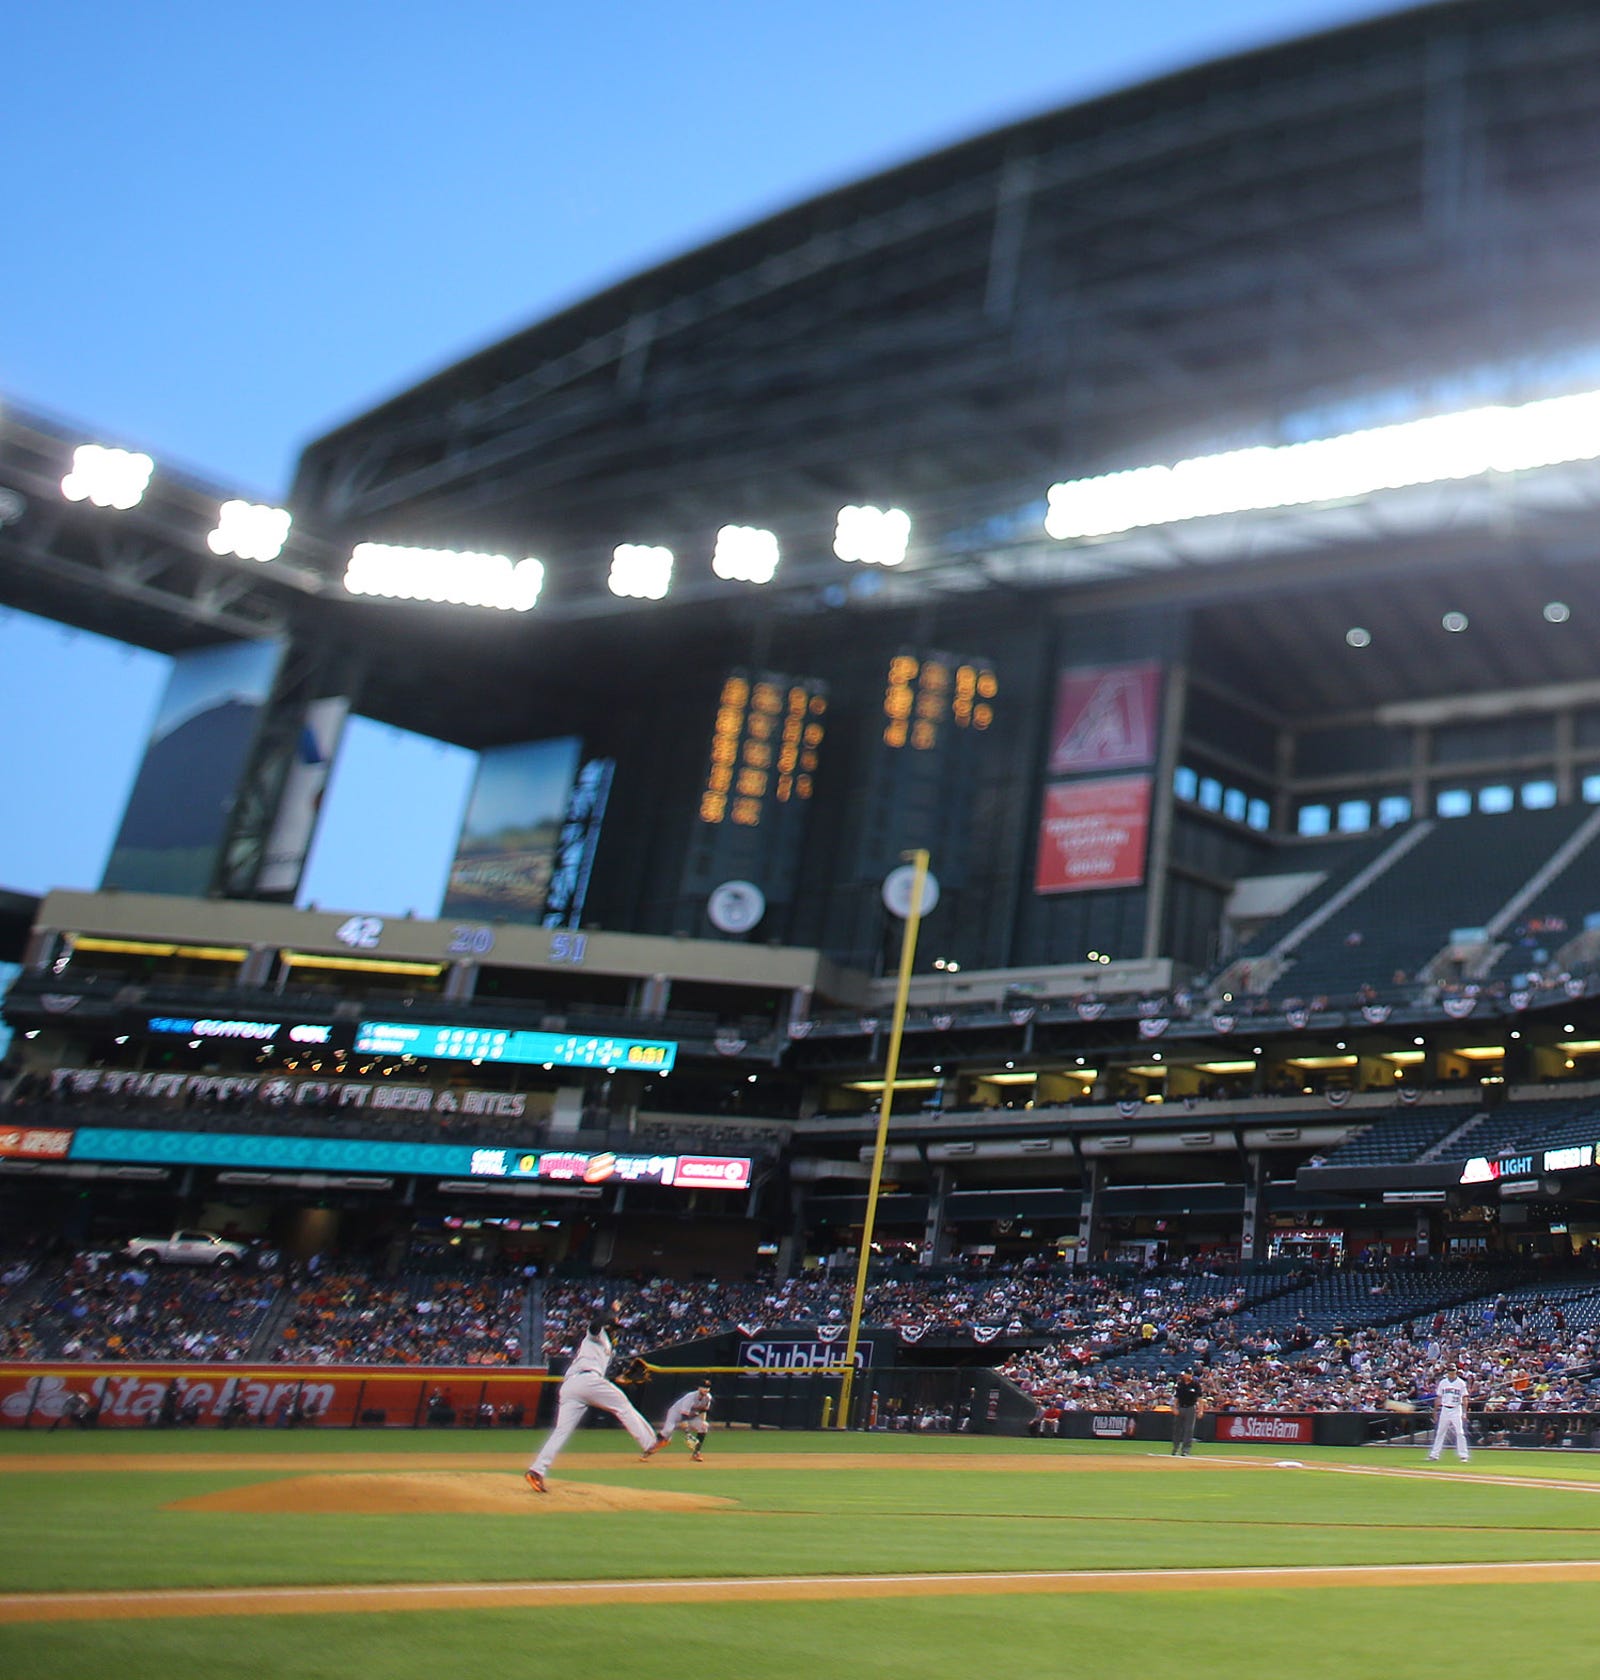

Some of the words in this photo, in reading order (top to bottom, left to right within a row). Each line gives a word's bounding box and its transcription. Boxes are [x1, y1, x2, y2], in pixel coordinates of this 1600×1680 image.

[336, 915, 384, 949] 42
[449, 925, 495, 954] 20
[550, 932, 588, 963] 51
[371, 1085, 434, 1112] BEER
[434, 1089, 458, 1113] &
[462, 1090, 527, 1117] BITES
[1500, 1156, 1533, 1176] LIGHT
